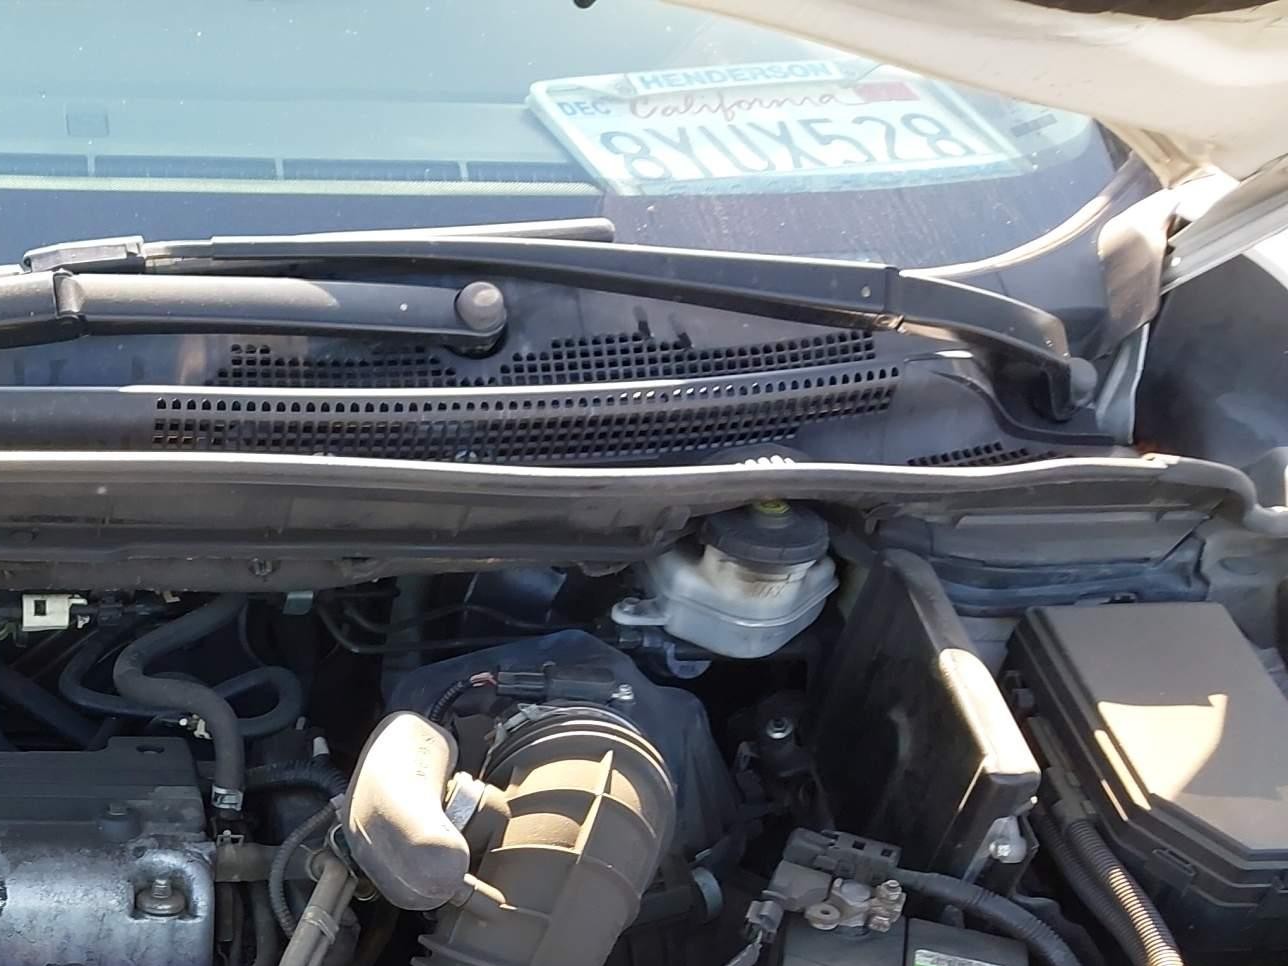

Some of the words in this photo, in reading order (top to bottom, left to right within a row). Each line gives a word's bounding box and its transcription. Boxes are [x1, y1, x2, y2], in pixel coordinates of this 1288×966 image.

[639, 60, 834, 91] HENDERSON
[557, 99, 610, 118] DEC
[628, 90, 844, 123] California
[599, 111, 978, 182] 8YUX528
